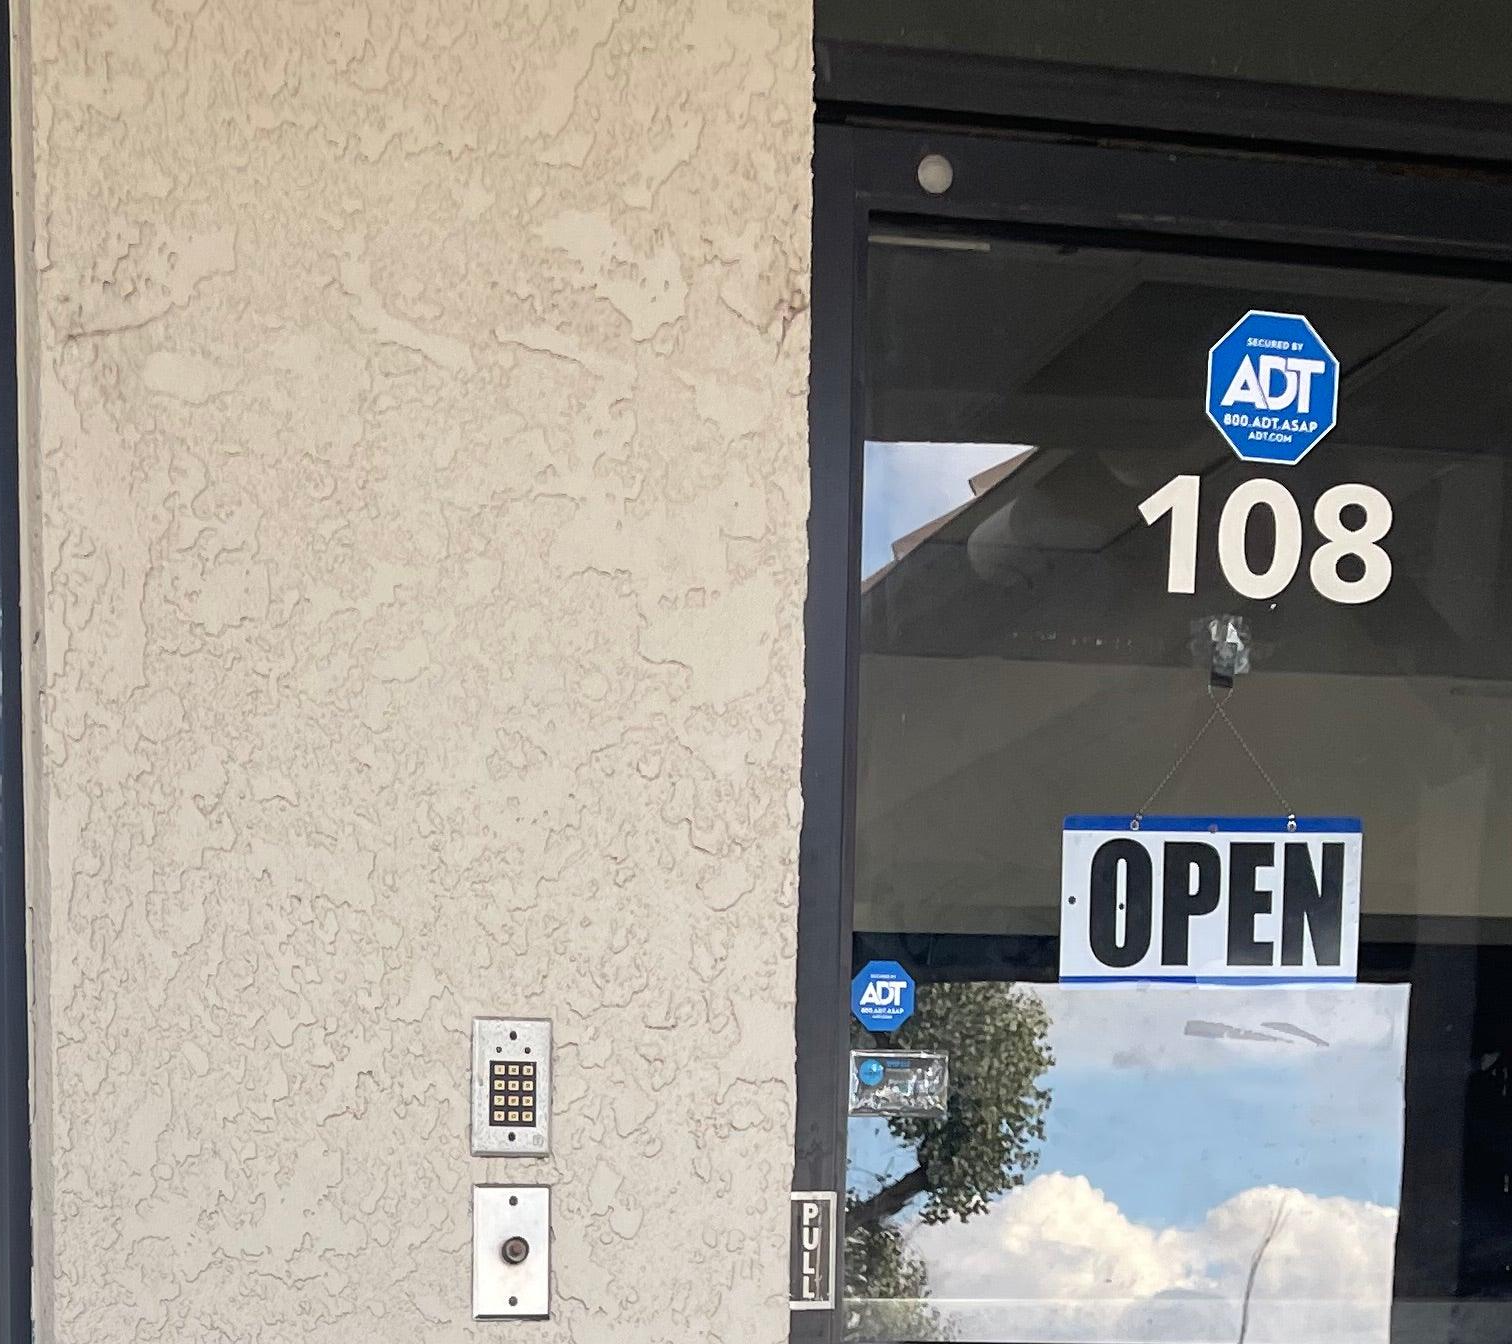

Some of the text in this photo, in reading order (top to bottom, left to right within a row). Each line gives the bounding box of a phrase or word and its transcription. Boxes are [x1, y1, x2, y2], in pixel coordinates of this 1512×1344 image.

[1246, 337, 1304, 352] SECURED BY
[1220, 353, 1326, 414] ADT
[1223, 413, 1318, 433] 800.ADT.ASAP
[1248, 431, 1293, 443] ADT.COM
[1138, 474, 1393, 604] 108
[1089, 837, 1345, 968] OPEN
[859, 980, 907, 1006] ADT
[803, 1202, 819, 1299] PULL
